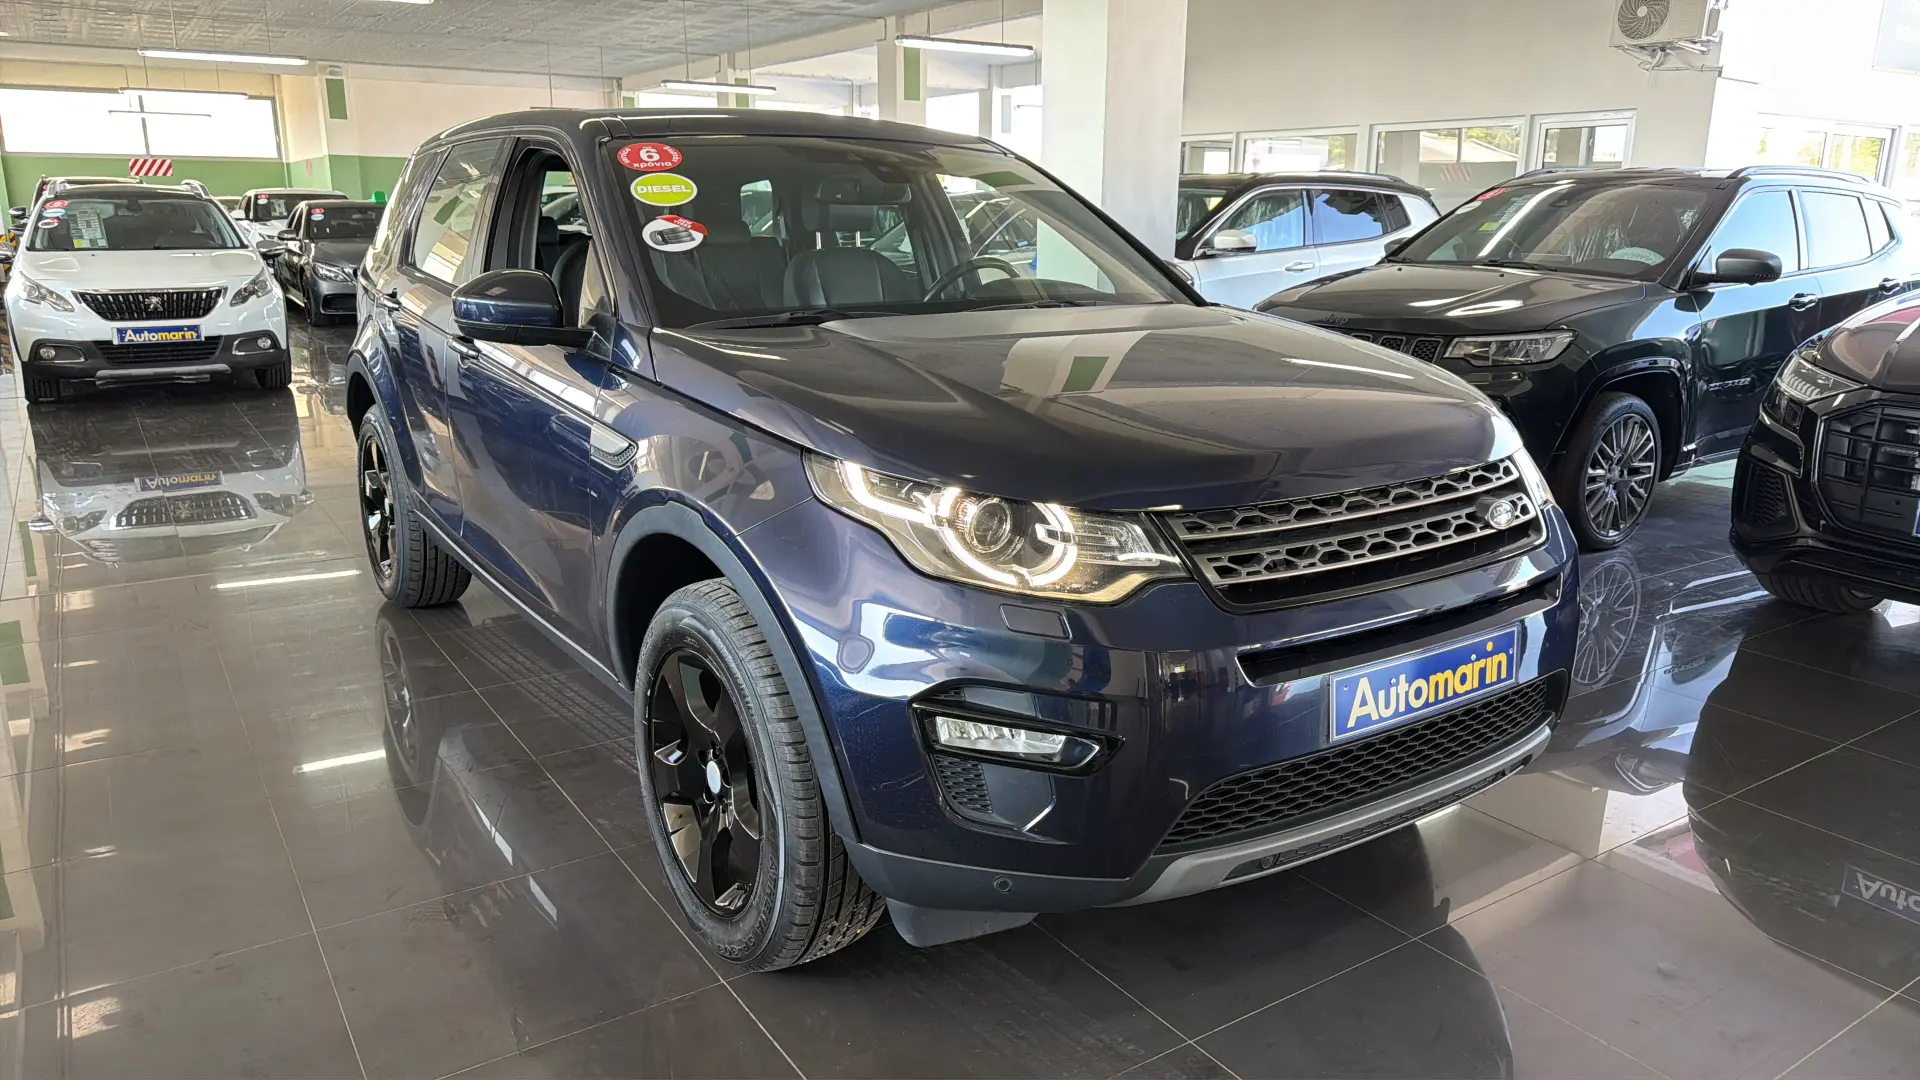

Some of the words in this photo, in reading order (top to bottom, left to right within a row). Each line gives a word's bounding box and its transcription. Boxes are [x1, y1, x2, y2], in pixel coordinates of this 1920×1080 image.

[639, 148, 661, 162] 6
[633, 161, 672, 169] χρόνια
[637, 185, 691, 194] DIESEL
[124, 327, 197, 342] Automarin
[1346, 641, 1508, 728] Automarin
